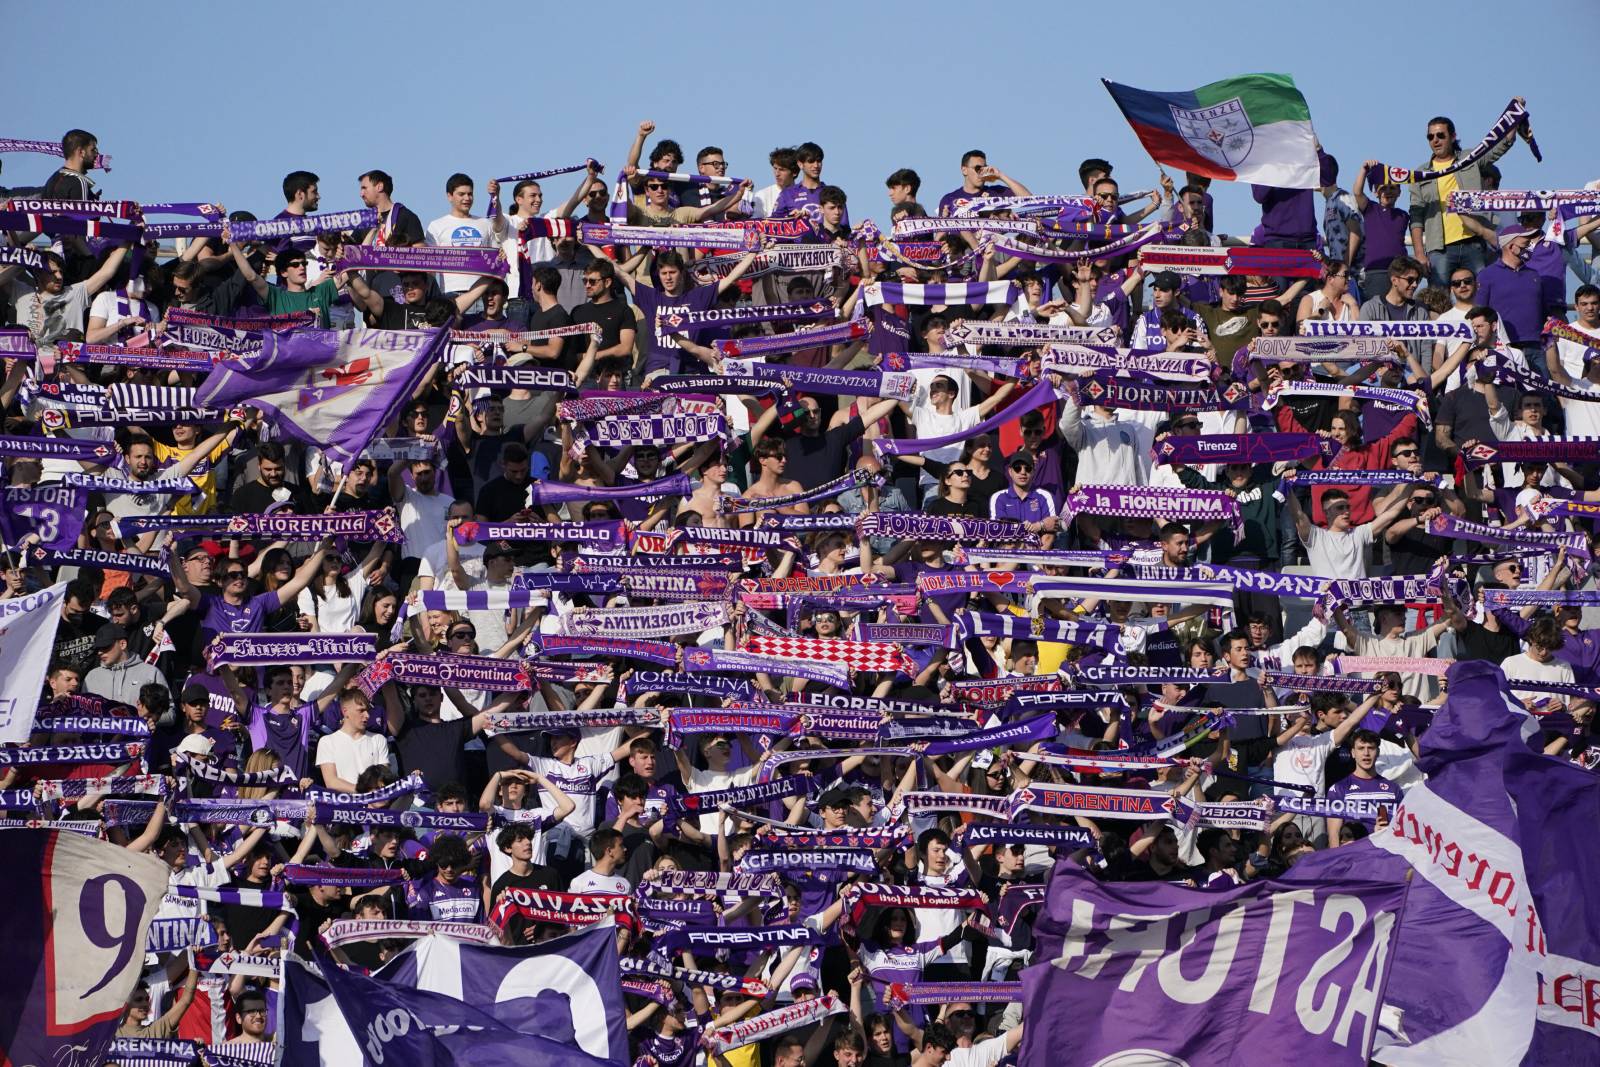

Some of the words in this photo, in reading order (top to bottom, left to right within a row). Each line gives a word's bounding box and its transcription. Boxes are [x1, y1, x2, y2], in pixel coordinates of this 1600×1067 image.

[1177, 101, 1238, 118] FIRENZE
[13, 200, 115, 214] FIORENTINA
[1484, 198, 1537, 210] FORZA
[255, 219, 300, 236] ONDA
[320, 212, 361, 232] URTO
[689, 304, 806, 324] FIORENTINA
[182, 327, 227, 348] FORZA
[1309, 322, 1375, 338] JUVE
[1381, 323, 1473, 339] MERDA
[1057, 349, 1108, 365] FORZA
[1116, 353, 1188, 373] RAGAZZI
[757, 367, 777, 380] WE
[780, 369, 801, 382] ARE
[802, 371, 878, 388] FIORENTINA
[1106, 385, 1221, 405] FIORENTINA
[1198, 440, 1238, 452] Firenze
[101, 475, 193, 490] FIORENTINA
[6, 487, 75, 508] ASTORI
[1096, 495, 1111, 508] la
[1120, 495, 1223, 513] FIORENTINA
[258, 518, 365, 534] FIORENTINA
[488, 527, 546, 539] BORDA
[567, 528, 610, 540] CULO
[877, 515, 953, 537] FORZA
[1454, 520, 1511, 541] PURPLE
[1515, 531, 1588, 550] CAVRIGLIA
[689, 527, 781, 546] FIORENTINA
[53, 549, 83, 562] ACF
[84, 549, 171, 574] FIORENTINA
[759, 575, 860, 592] FIORENTINA
[392, 659, 436, 677] Forza
[439, 661, 513, 682] Fiorentina
[1110, 666, 1210, 680] FIORENTINA
[32, 718, 61, 733] ACF
[681, 712, 781, 728] FIORENTINA
[19, 748, 51, 763] MY
[57, 743, 122, 762] DRUG
[321, 774, 424, 805] FIORENTINA
[701, 778, 794, 809] FIORENTINA
[1043, 791, 1154, 813] FIORENTINA
[1279, 796, 1313, 811] ACF
[331, 809, 394, 825] BRIGATE
[969, 826, 999, 841] ACF
[1001, 827, 1091, 844] FIORENTINA
[741, 852, 771, 869] ACF
[773, 851, 875, 869] FIORENTINA
[79, 873, 148, 1000] 9
[328, 920, 403, 941] COLLETTIVO
[427, 919, 495, 939] AUTONOMO
[688, 928, 810, 944] FIORENTINA
